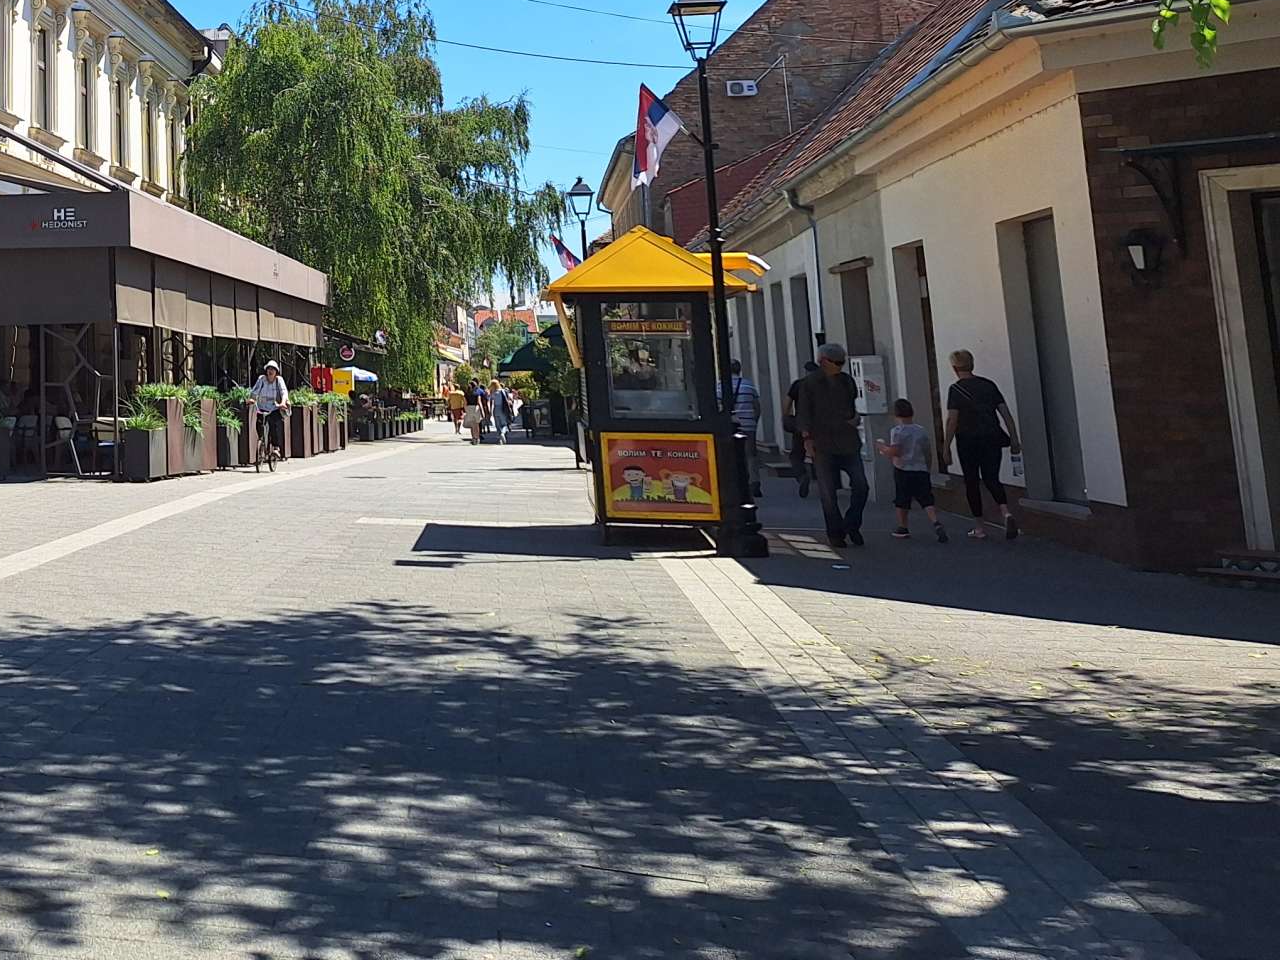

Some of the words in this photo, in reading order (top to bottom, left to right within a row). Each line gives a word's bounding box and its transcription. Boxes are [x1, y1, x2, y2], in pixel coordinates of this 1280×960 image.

[53, 208, 75, 220] HE
[41, 220, 87, 229] HEDONIST
[618, 449, 647, 458] ВОЛИМ
[651, 449, 663, 458] ТЕ
[667, 450, 699, 459] КОКИЦЕ
